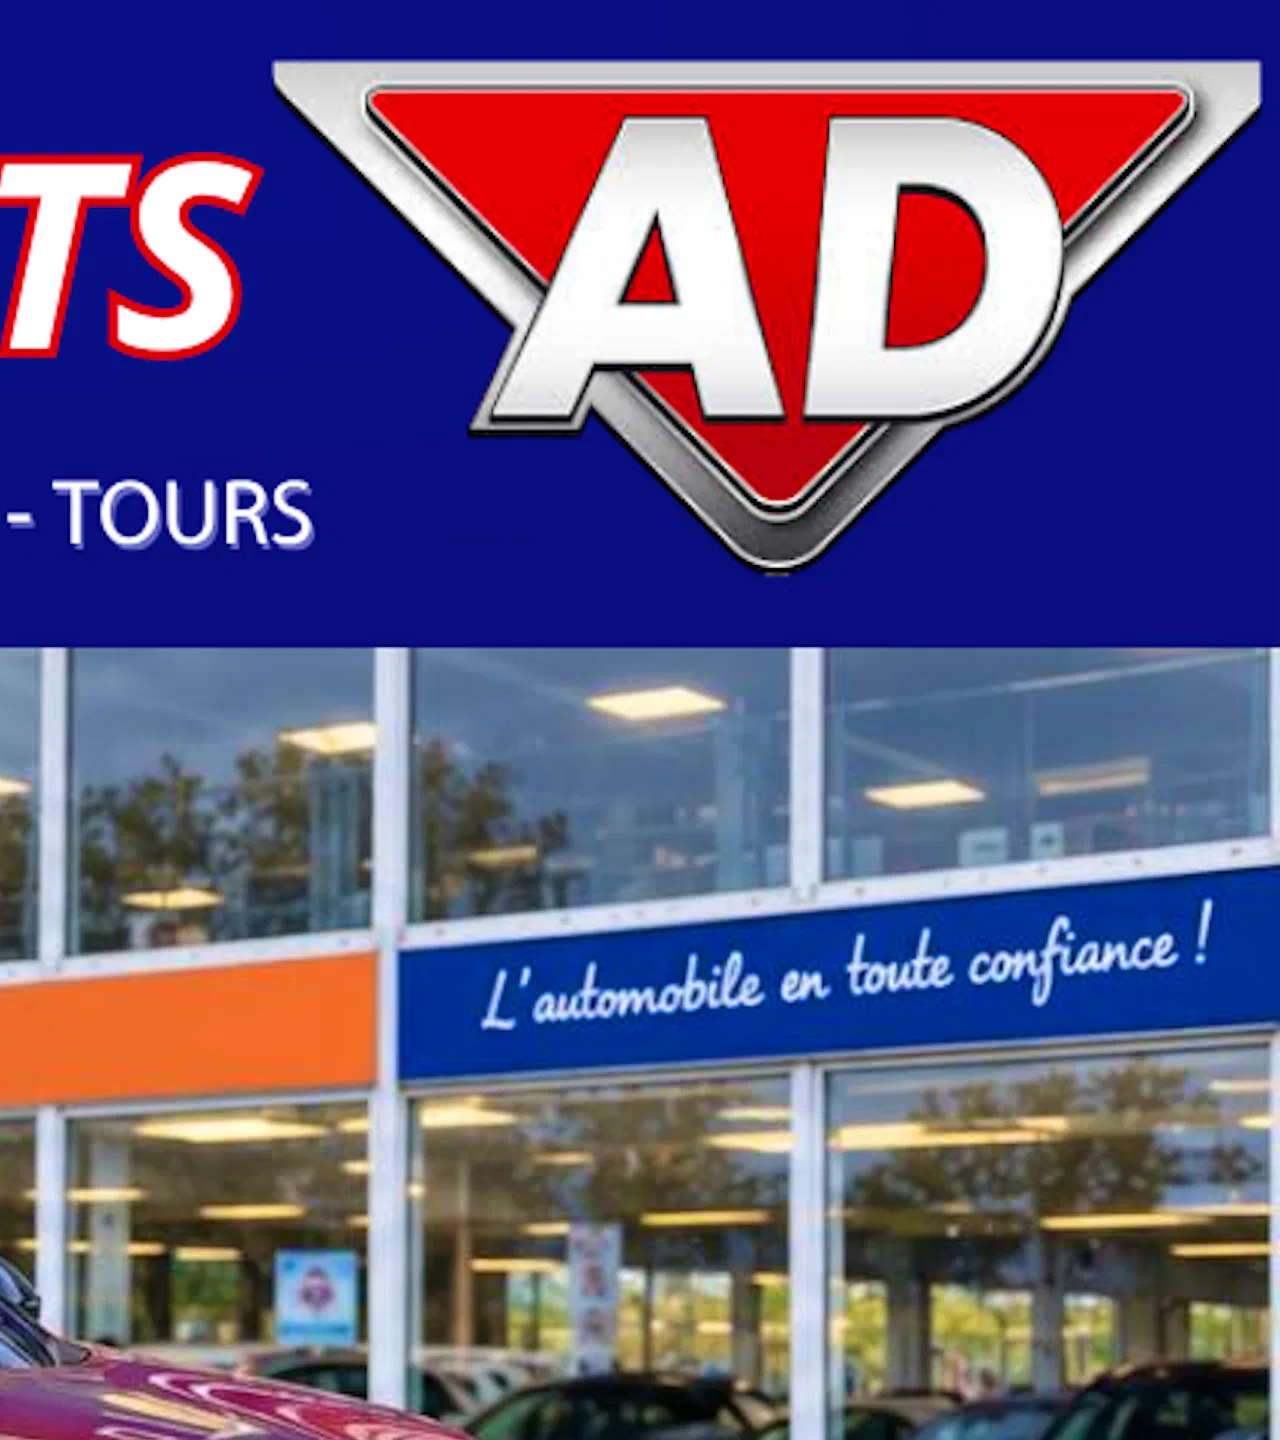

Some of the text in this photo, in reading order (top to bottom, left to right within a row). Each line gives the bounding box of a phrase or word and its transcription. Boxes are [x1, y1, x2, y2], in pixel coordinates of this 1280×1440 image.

[480, 950, 765, 1030] L'automobile
[781, 969, 831, 1003] en
[846, 928, 954, 996] toute
[968, 914, 1180, 1008] confiance
